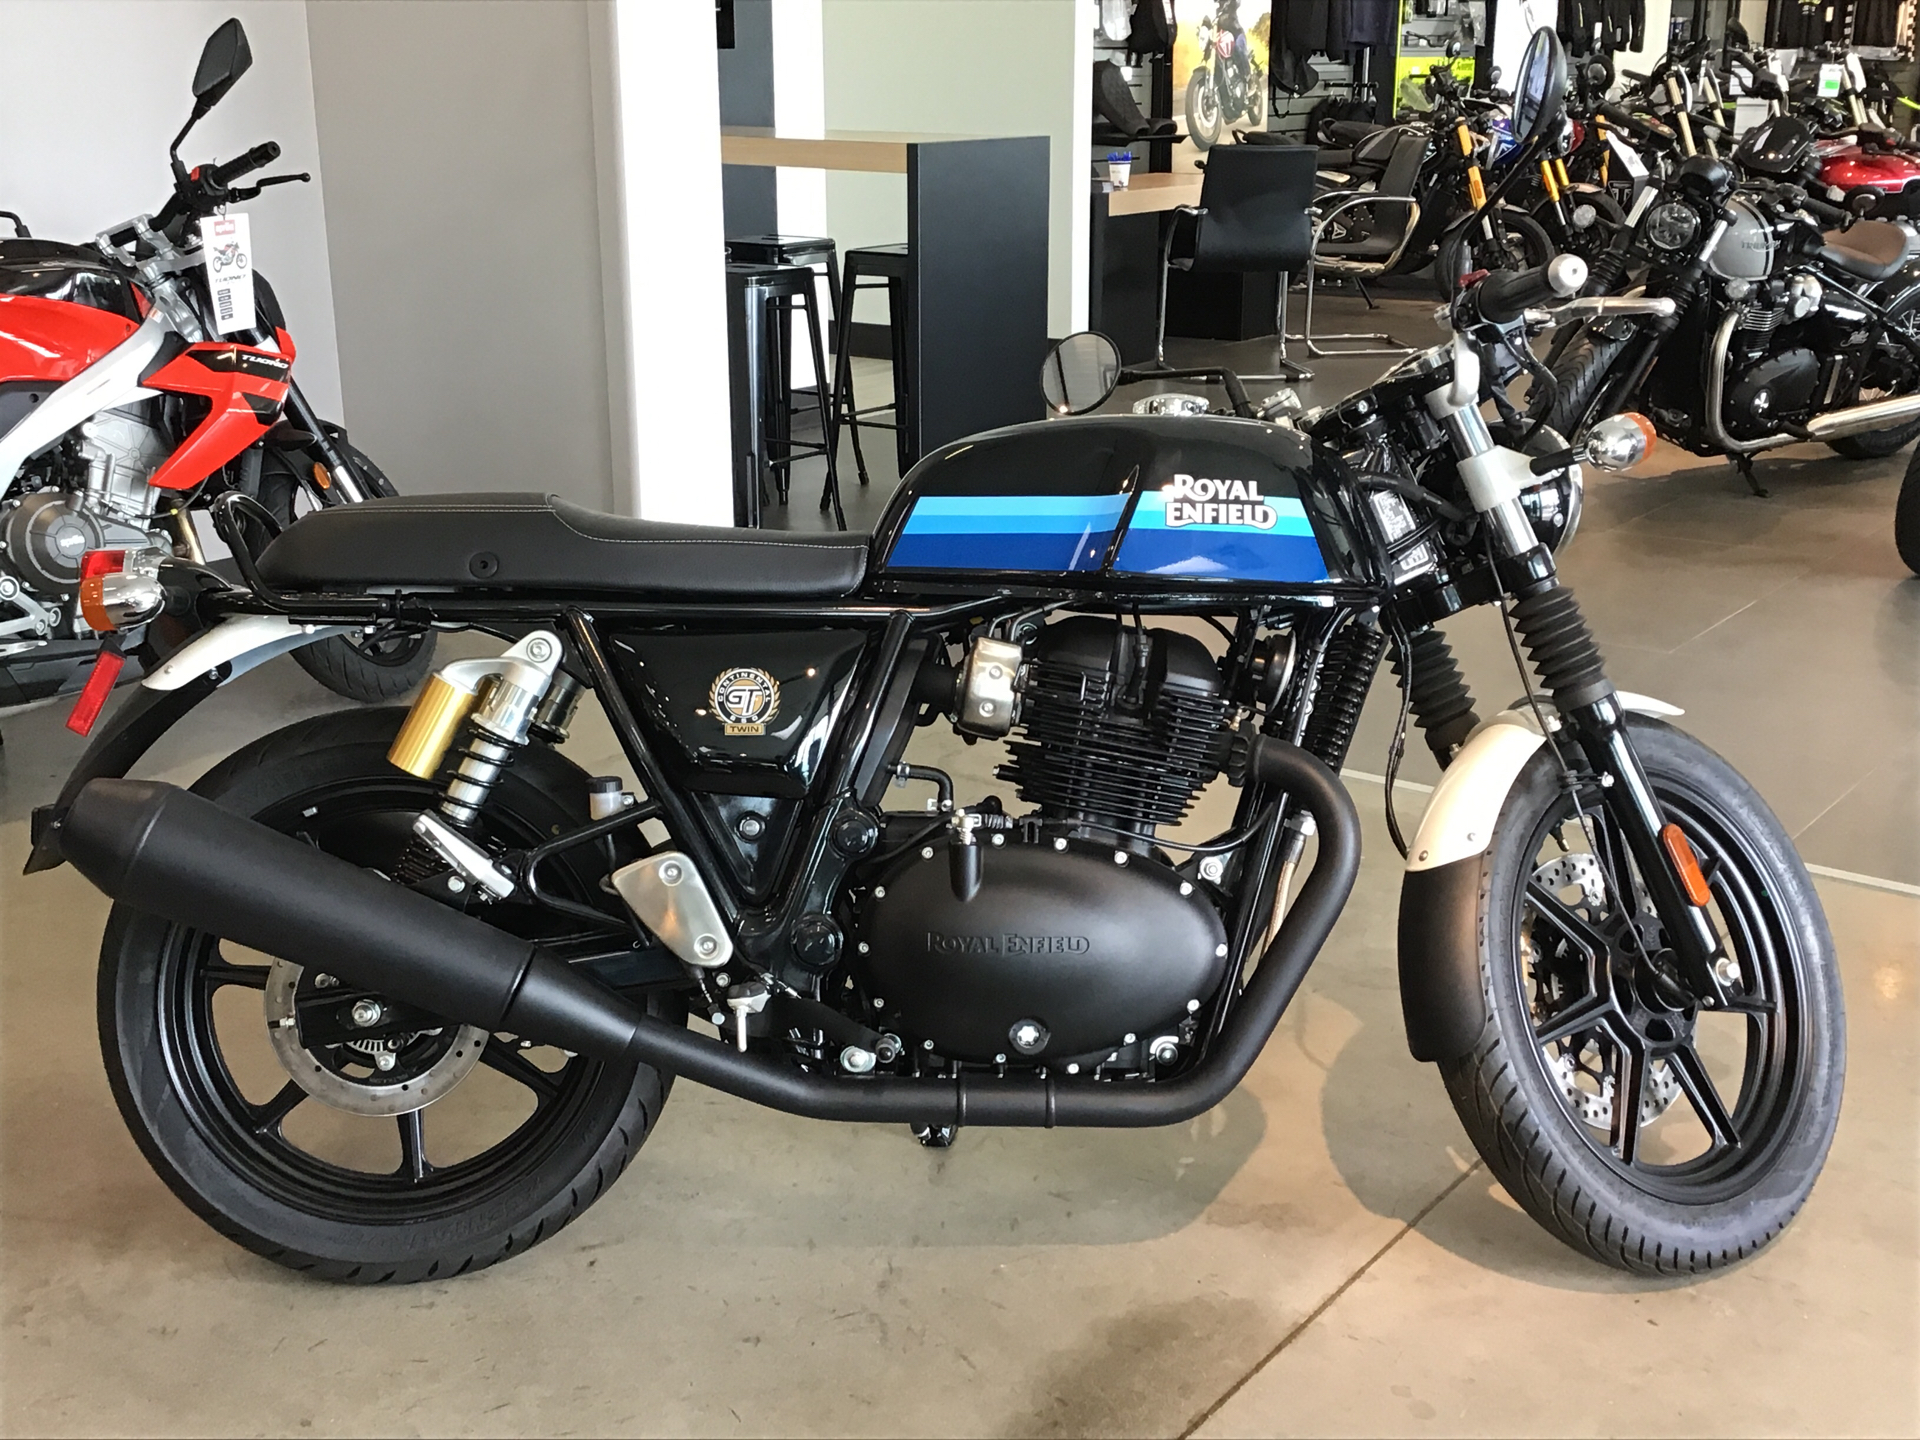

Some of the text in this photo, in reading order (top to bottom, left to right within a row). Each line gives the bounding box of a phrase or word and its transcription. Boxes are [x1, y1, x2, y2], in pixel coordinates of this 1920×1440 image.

[241, 354, 289, 369] TUONO
[1174, 474, 1264, 501] ROYAL
[1165, 502, 1278, 530] ENFIELD
[717, 672, 771, 702] CONTINENTAL
[726, 685, 763, 716] GT
[927, 931, 1090, 956] ROYAL ENFIELD
